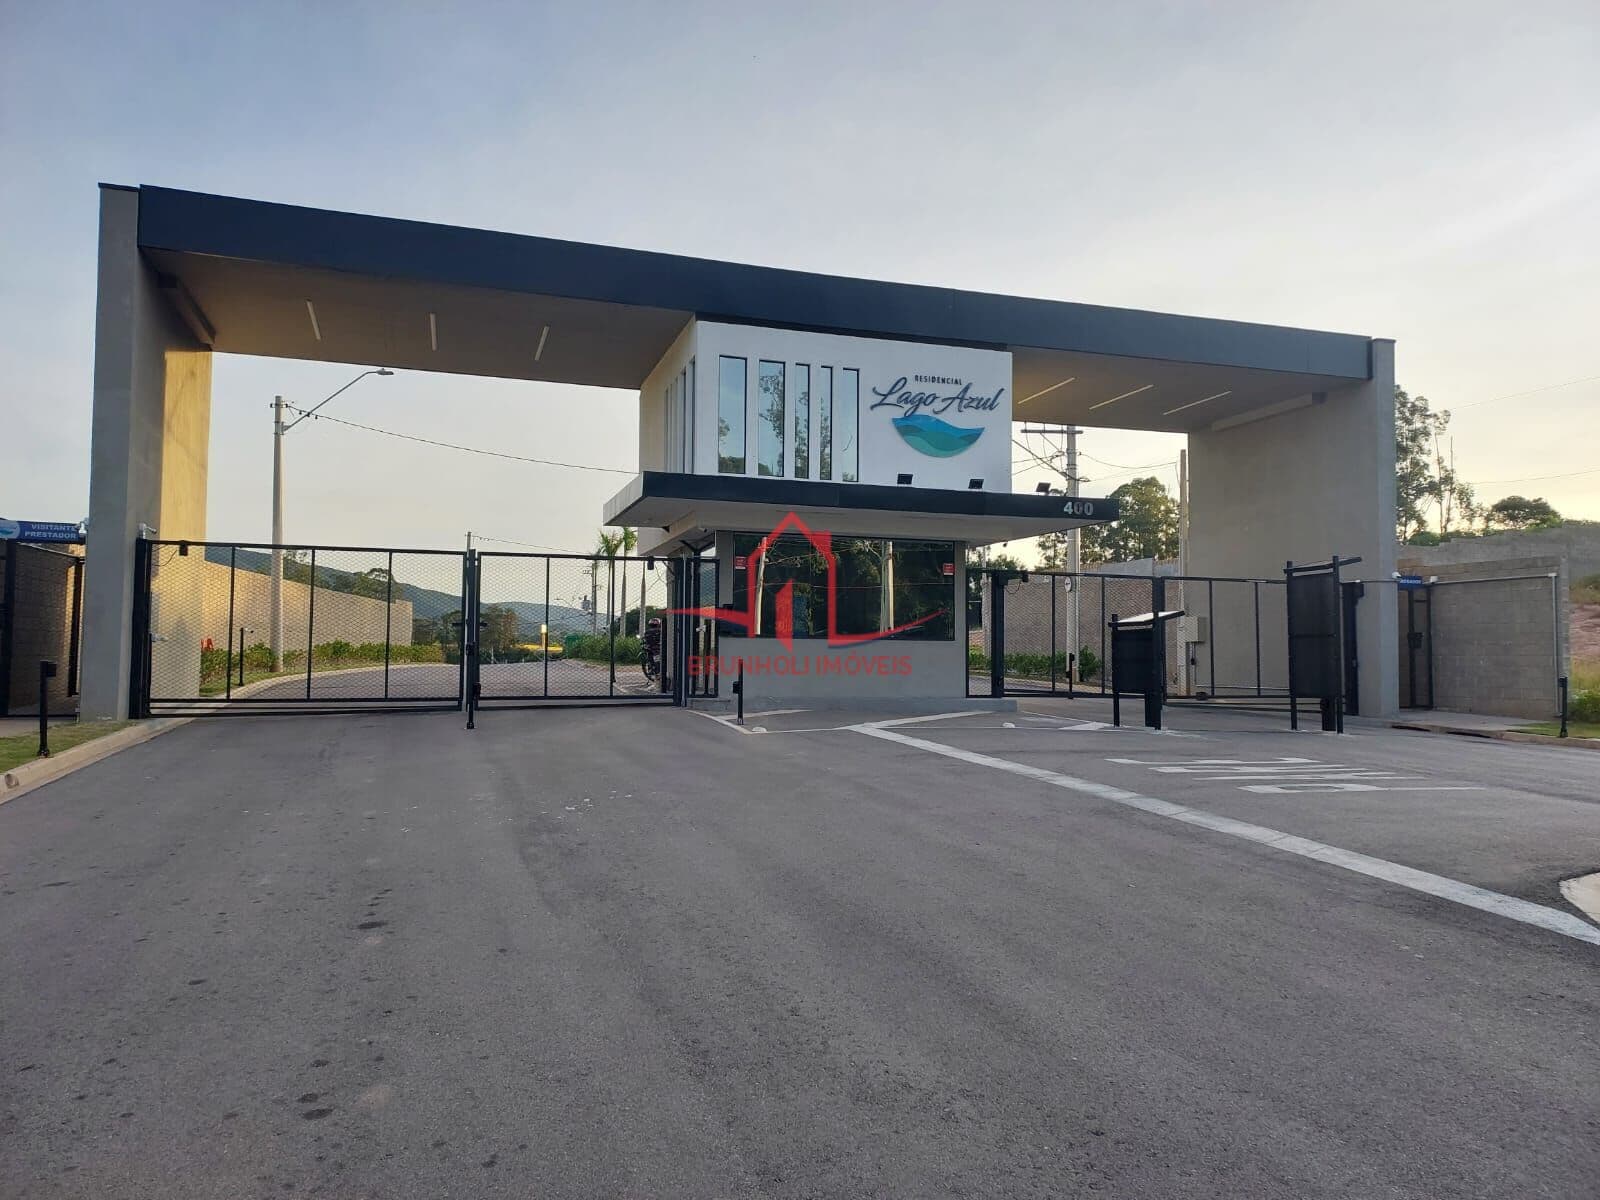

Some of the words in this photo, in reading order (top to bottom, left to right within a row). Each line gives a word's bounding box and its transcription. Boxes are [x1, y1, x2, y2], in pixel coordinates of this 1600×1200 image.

[914, 374, 963, 385] RESIDENCIAL
[870, 376, 939, 417] Lago
[932, 382, 1005, 415] Azul
[1063, 501, 1094, 516] 400
[24, 531, 77, 539] PRESTADOR
